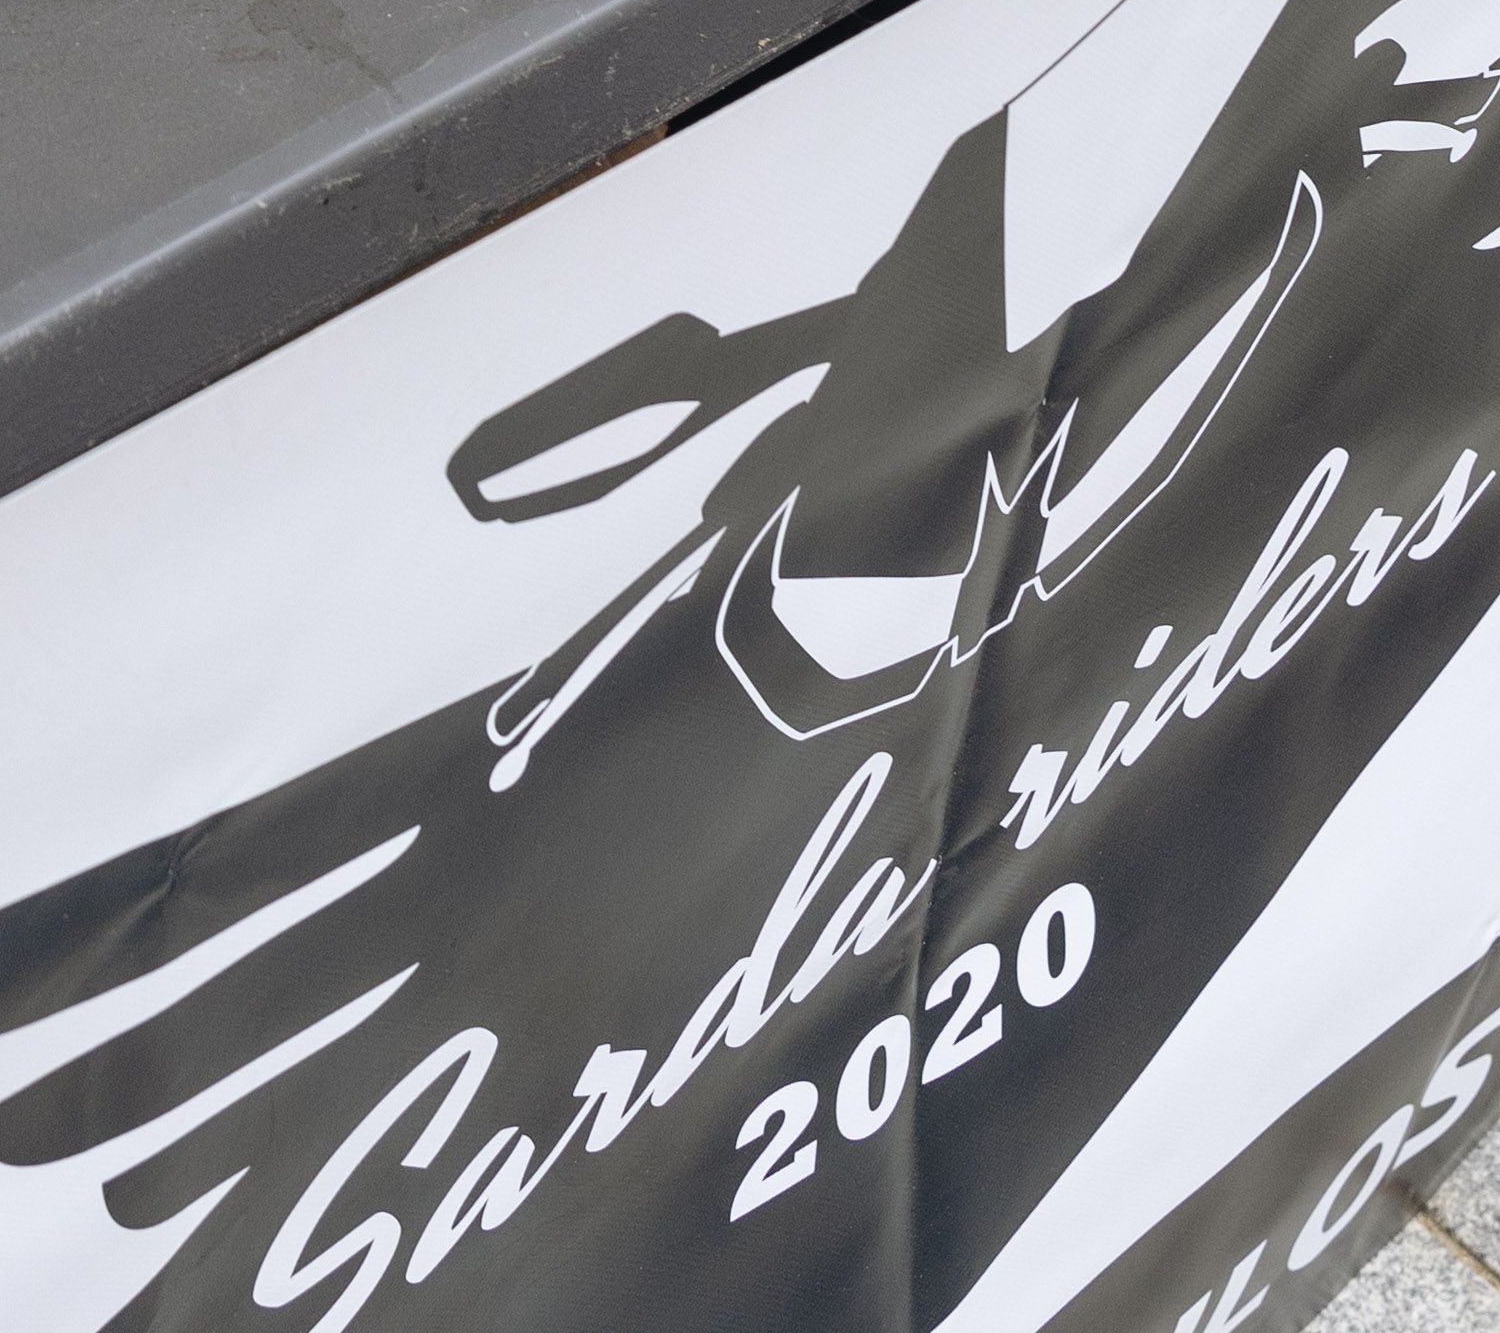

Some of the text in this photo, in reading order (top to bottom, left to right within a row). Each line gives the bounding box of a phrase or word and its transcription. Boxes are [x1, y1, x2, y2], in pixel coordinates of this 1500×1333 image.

[252, 446, 1499, 1333] Sarda riders
[729, 881, 1098, 1224] 2020
